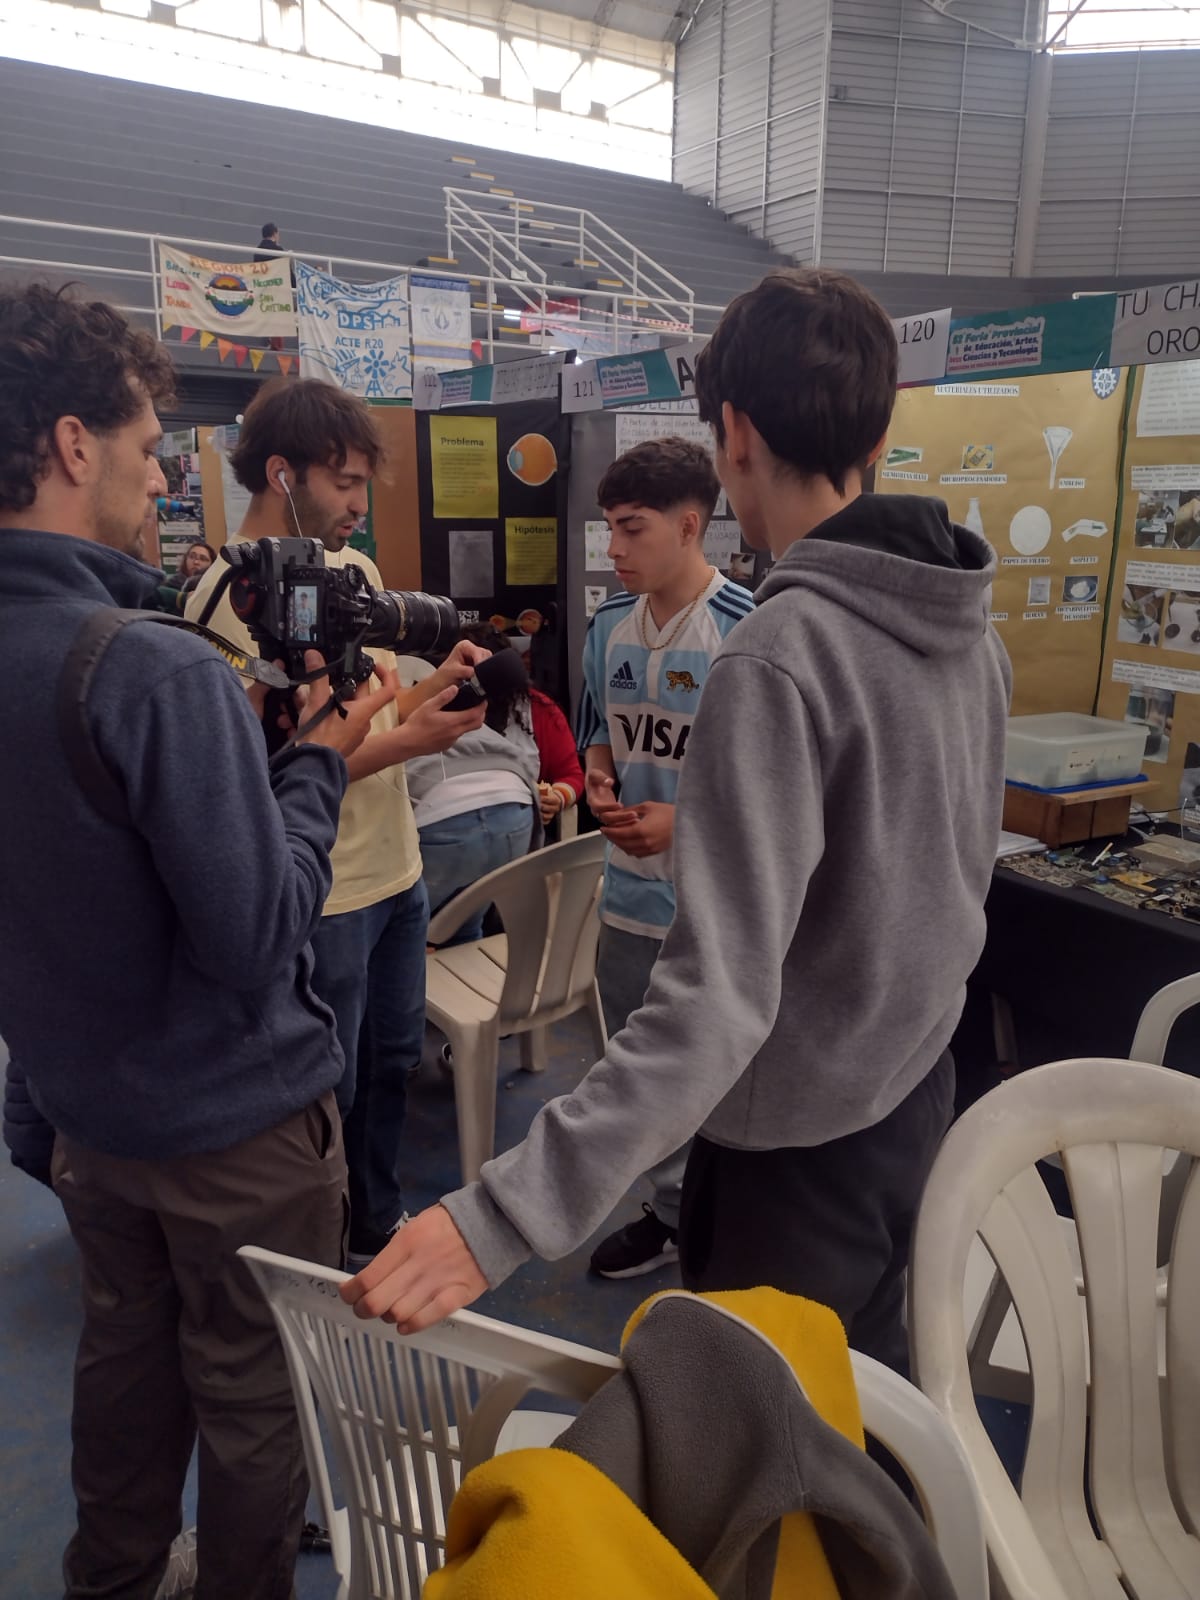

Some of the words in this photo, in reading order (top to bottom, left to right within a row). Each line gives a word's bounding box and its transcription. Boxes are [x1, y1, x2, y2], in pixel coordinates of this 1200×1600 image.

[1118, 289, 1148, 318] TU
[339, 312, 374, 330] DPS
[899, 317, 936, 345] 120
[336, 336, 361, 348] ACTE
[365, 338, 384, 349] R20
[574, 380, 595, 398] 121
[441, 437, 484, 447] Problema
[515, 525, 555, 537] Hipótesis
[609, 679, 638, 690] adidas
